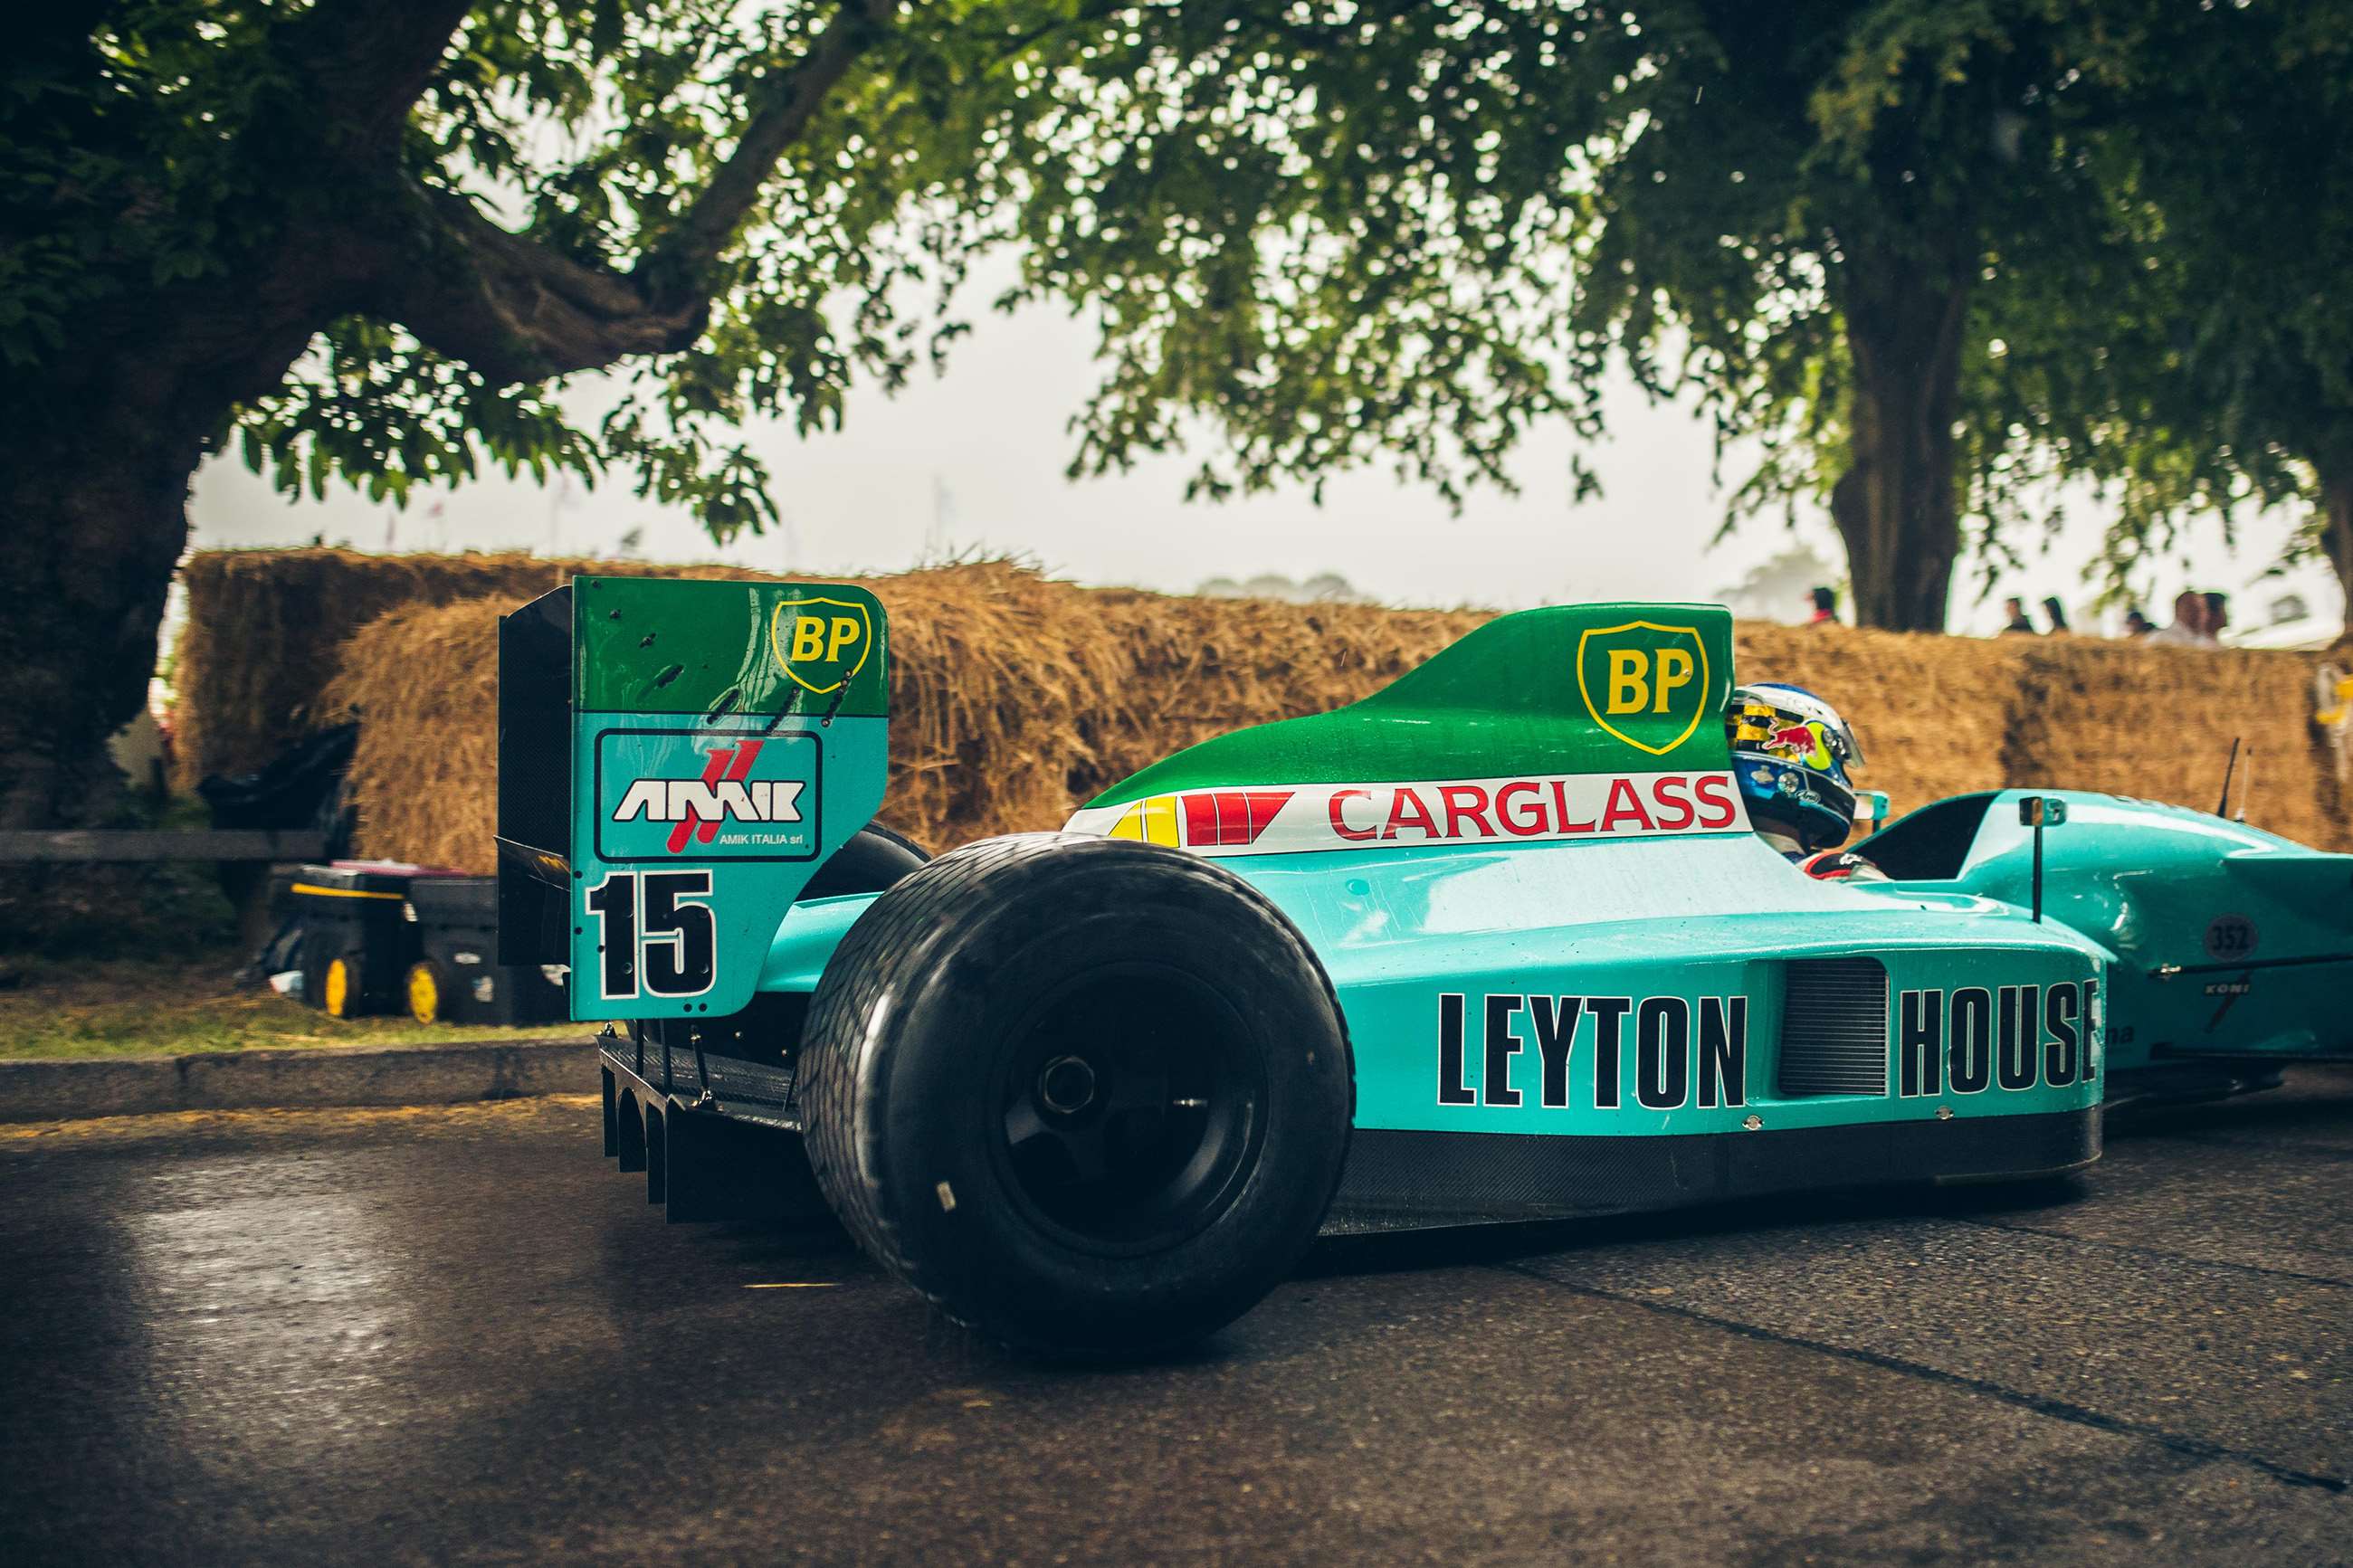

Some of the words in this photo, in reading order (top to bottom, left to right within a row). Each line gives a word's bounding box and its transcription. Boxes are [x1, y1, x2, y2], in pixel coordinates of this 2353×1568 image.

[791, 615, 861, 663] BP
[1605, 648, 1694, 715] BP
[1328, 774, 1737, 841] CARGLASS
[719, 834, 749, 845] AMIK
[752, 834, 787, 845] ITALIA
[789, 834, 804, 845] srl
[585, 869, 718, 1000] 15
[2212, 925, 2250, 950] 352
[2205, 983, 2251, 994] KONI
[1437, 993, 1748, 1111] LEYTON
